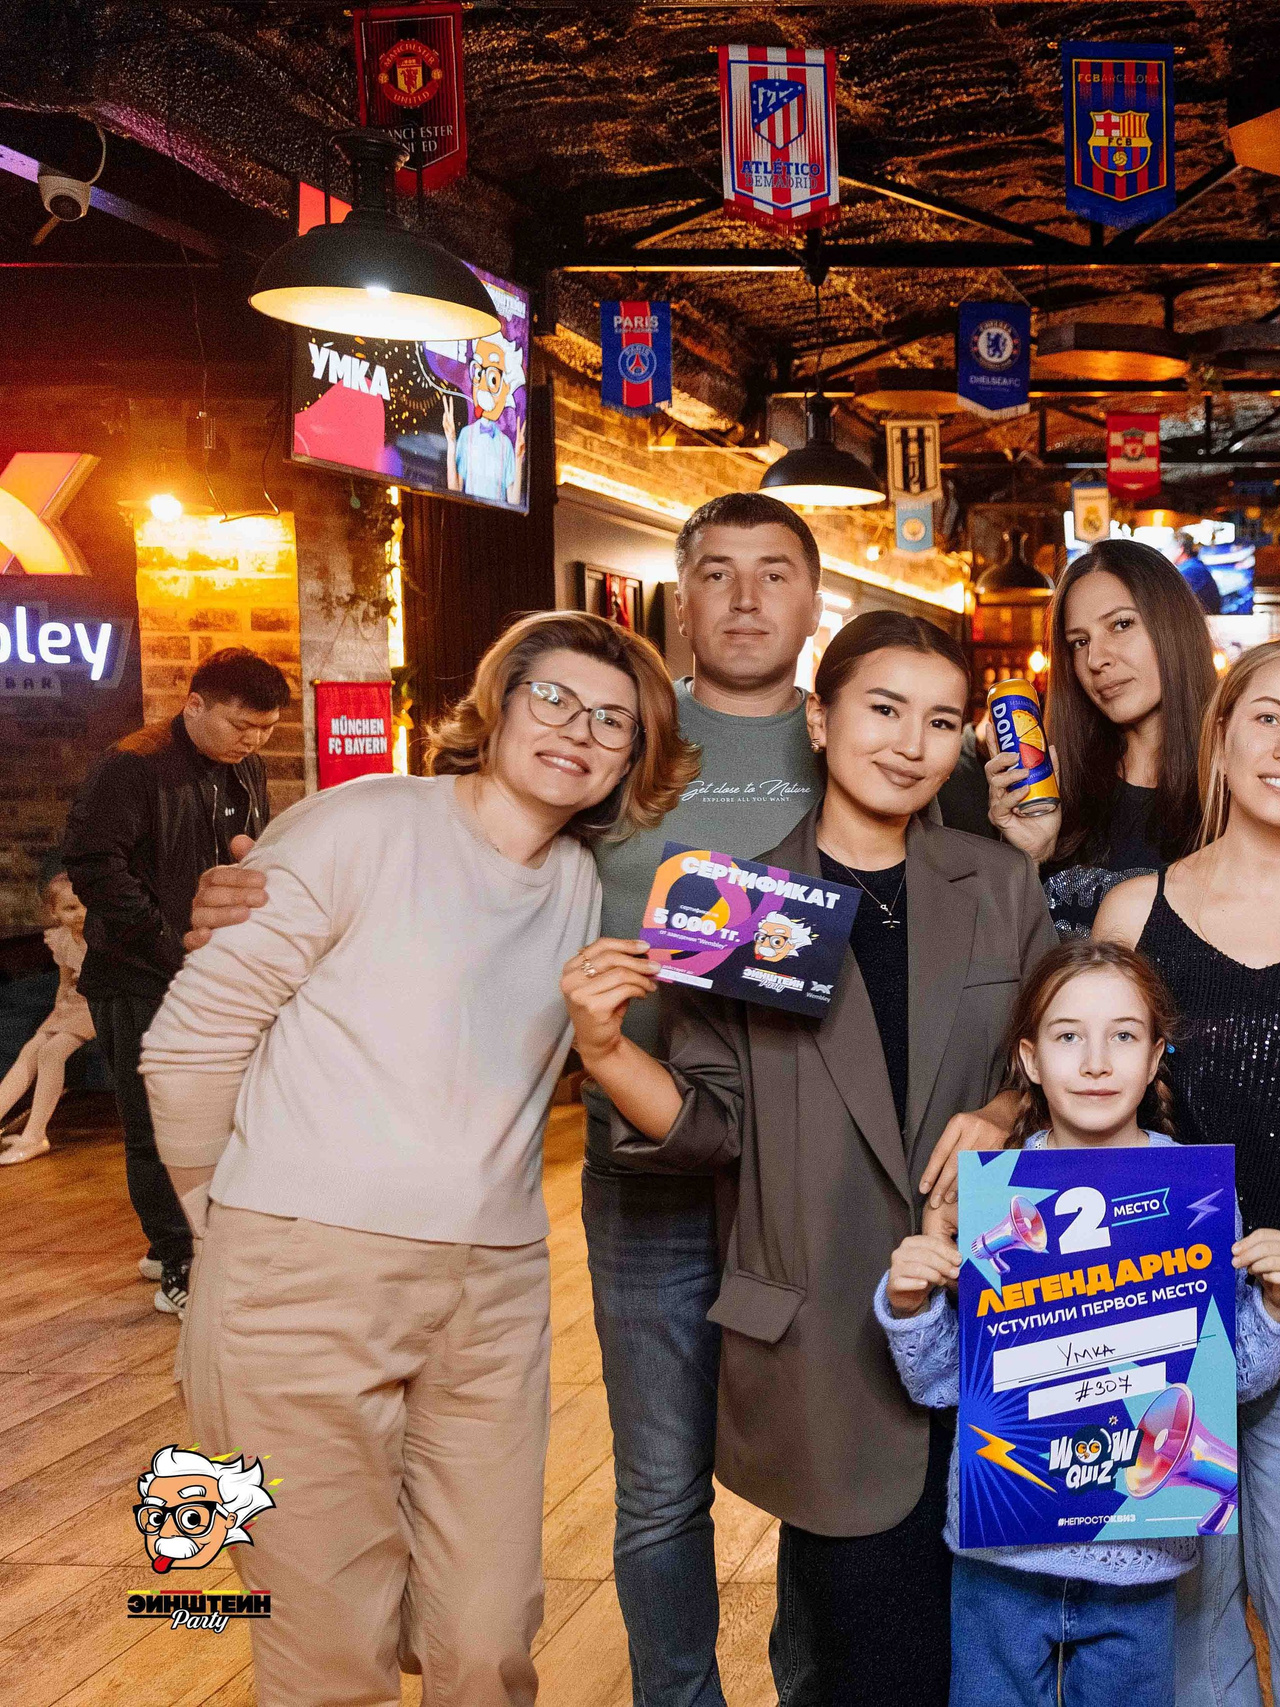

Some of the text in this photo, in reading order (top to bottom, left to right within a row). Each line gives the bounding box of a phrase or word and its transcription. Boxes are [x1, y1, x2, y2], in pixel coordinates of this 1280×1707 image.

[741, 158, 821, 176] ATLÉTICO
[613, 315, 659, 329] PARIS
[308, 341, 391, 401] УМКА
[331, 715, 384, 735] MÜNCHEN
[329, 737, 387, 755] FC BAYERN
[680, 780, 812, 801] Get close to Nature
[681, 857, 840, 909] СЕРТИФИКАТ
[653, 907, 669, 924] 5
[671, 912, 717, 935] 000
[1054, 1186, 1160, 1255] 2 МЕСТО
[976, 1243, 1213, 1318] ЛЕГЕНДАРНО
[987, 1279, 1208, 1337] УСТУПИЛИ ПЕРВОЕ МЕСТО
[1074, 1374, 1133, 1402] #307
[1065, 1459, 1115, 1490] QUIZ
[1057, 1513, 1136, 1527] #НЕПРОСТОКВИЗ
